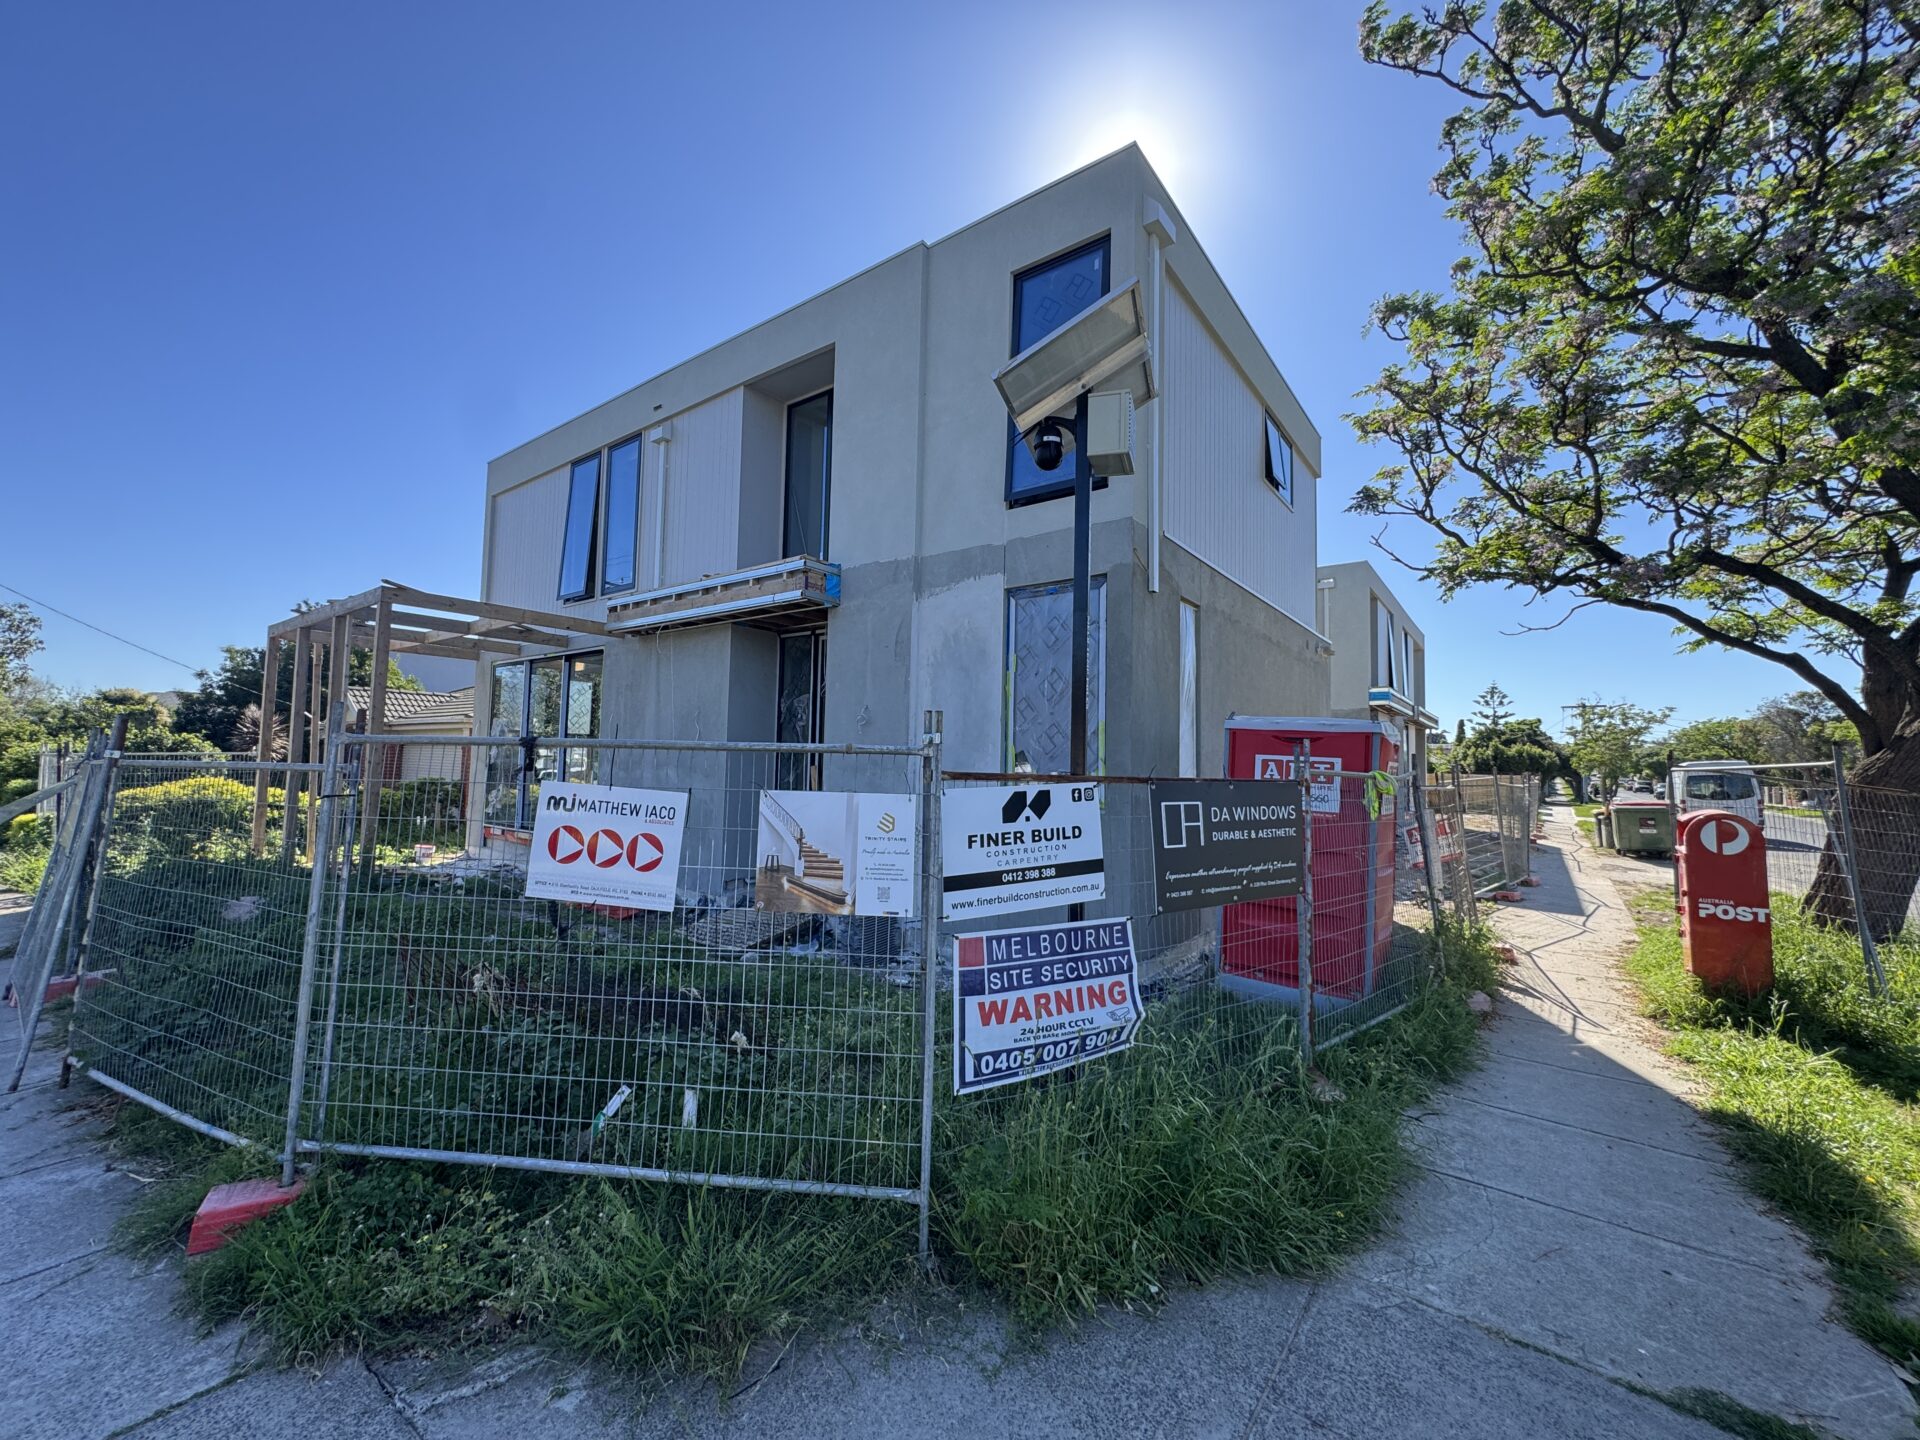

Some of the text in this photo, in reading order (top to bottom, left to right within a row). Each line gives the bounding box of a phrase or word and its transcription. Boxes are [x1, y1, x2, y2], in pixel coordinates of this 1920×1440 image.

[578, 798, 642, 818] MATTHEW
[645, 804, 676, 821] IACO
[1210, 805, 1296, 822] DA WINDOWS
[968, 826, 1082, 850] FINER BUILD
[1212, 828, 1296, 841] DURABLE & AESTHETIC
[986, 844, 1067, 858] CONSTRUCTION
[996, 854, 1059, 867] CARPENTRY
[1002, 867, 1056, 882] 0412 398 388
[952, 882, 1100, 910] www.finerbuildconstruction.com.au
[1698, 897, 1734, 905] AUSTRALIA
[1698, 903, 1770, 923] POST
[992, 926, 1124, 961] MELBOURNE
[990, 954, 1129, 990] SITE SECURITY
[978, 980, 1128, 1027] WARNING
[1020, 1016, 1094, 1036] 24 HOUR CCTV
[1014, 1035, 1032, 1043] BACK
[1042, 1032, 1060, 1040] BASE
[980, 1048, 1035, 1075] 0405
[1042, 1038, 1080, 1062] 007
